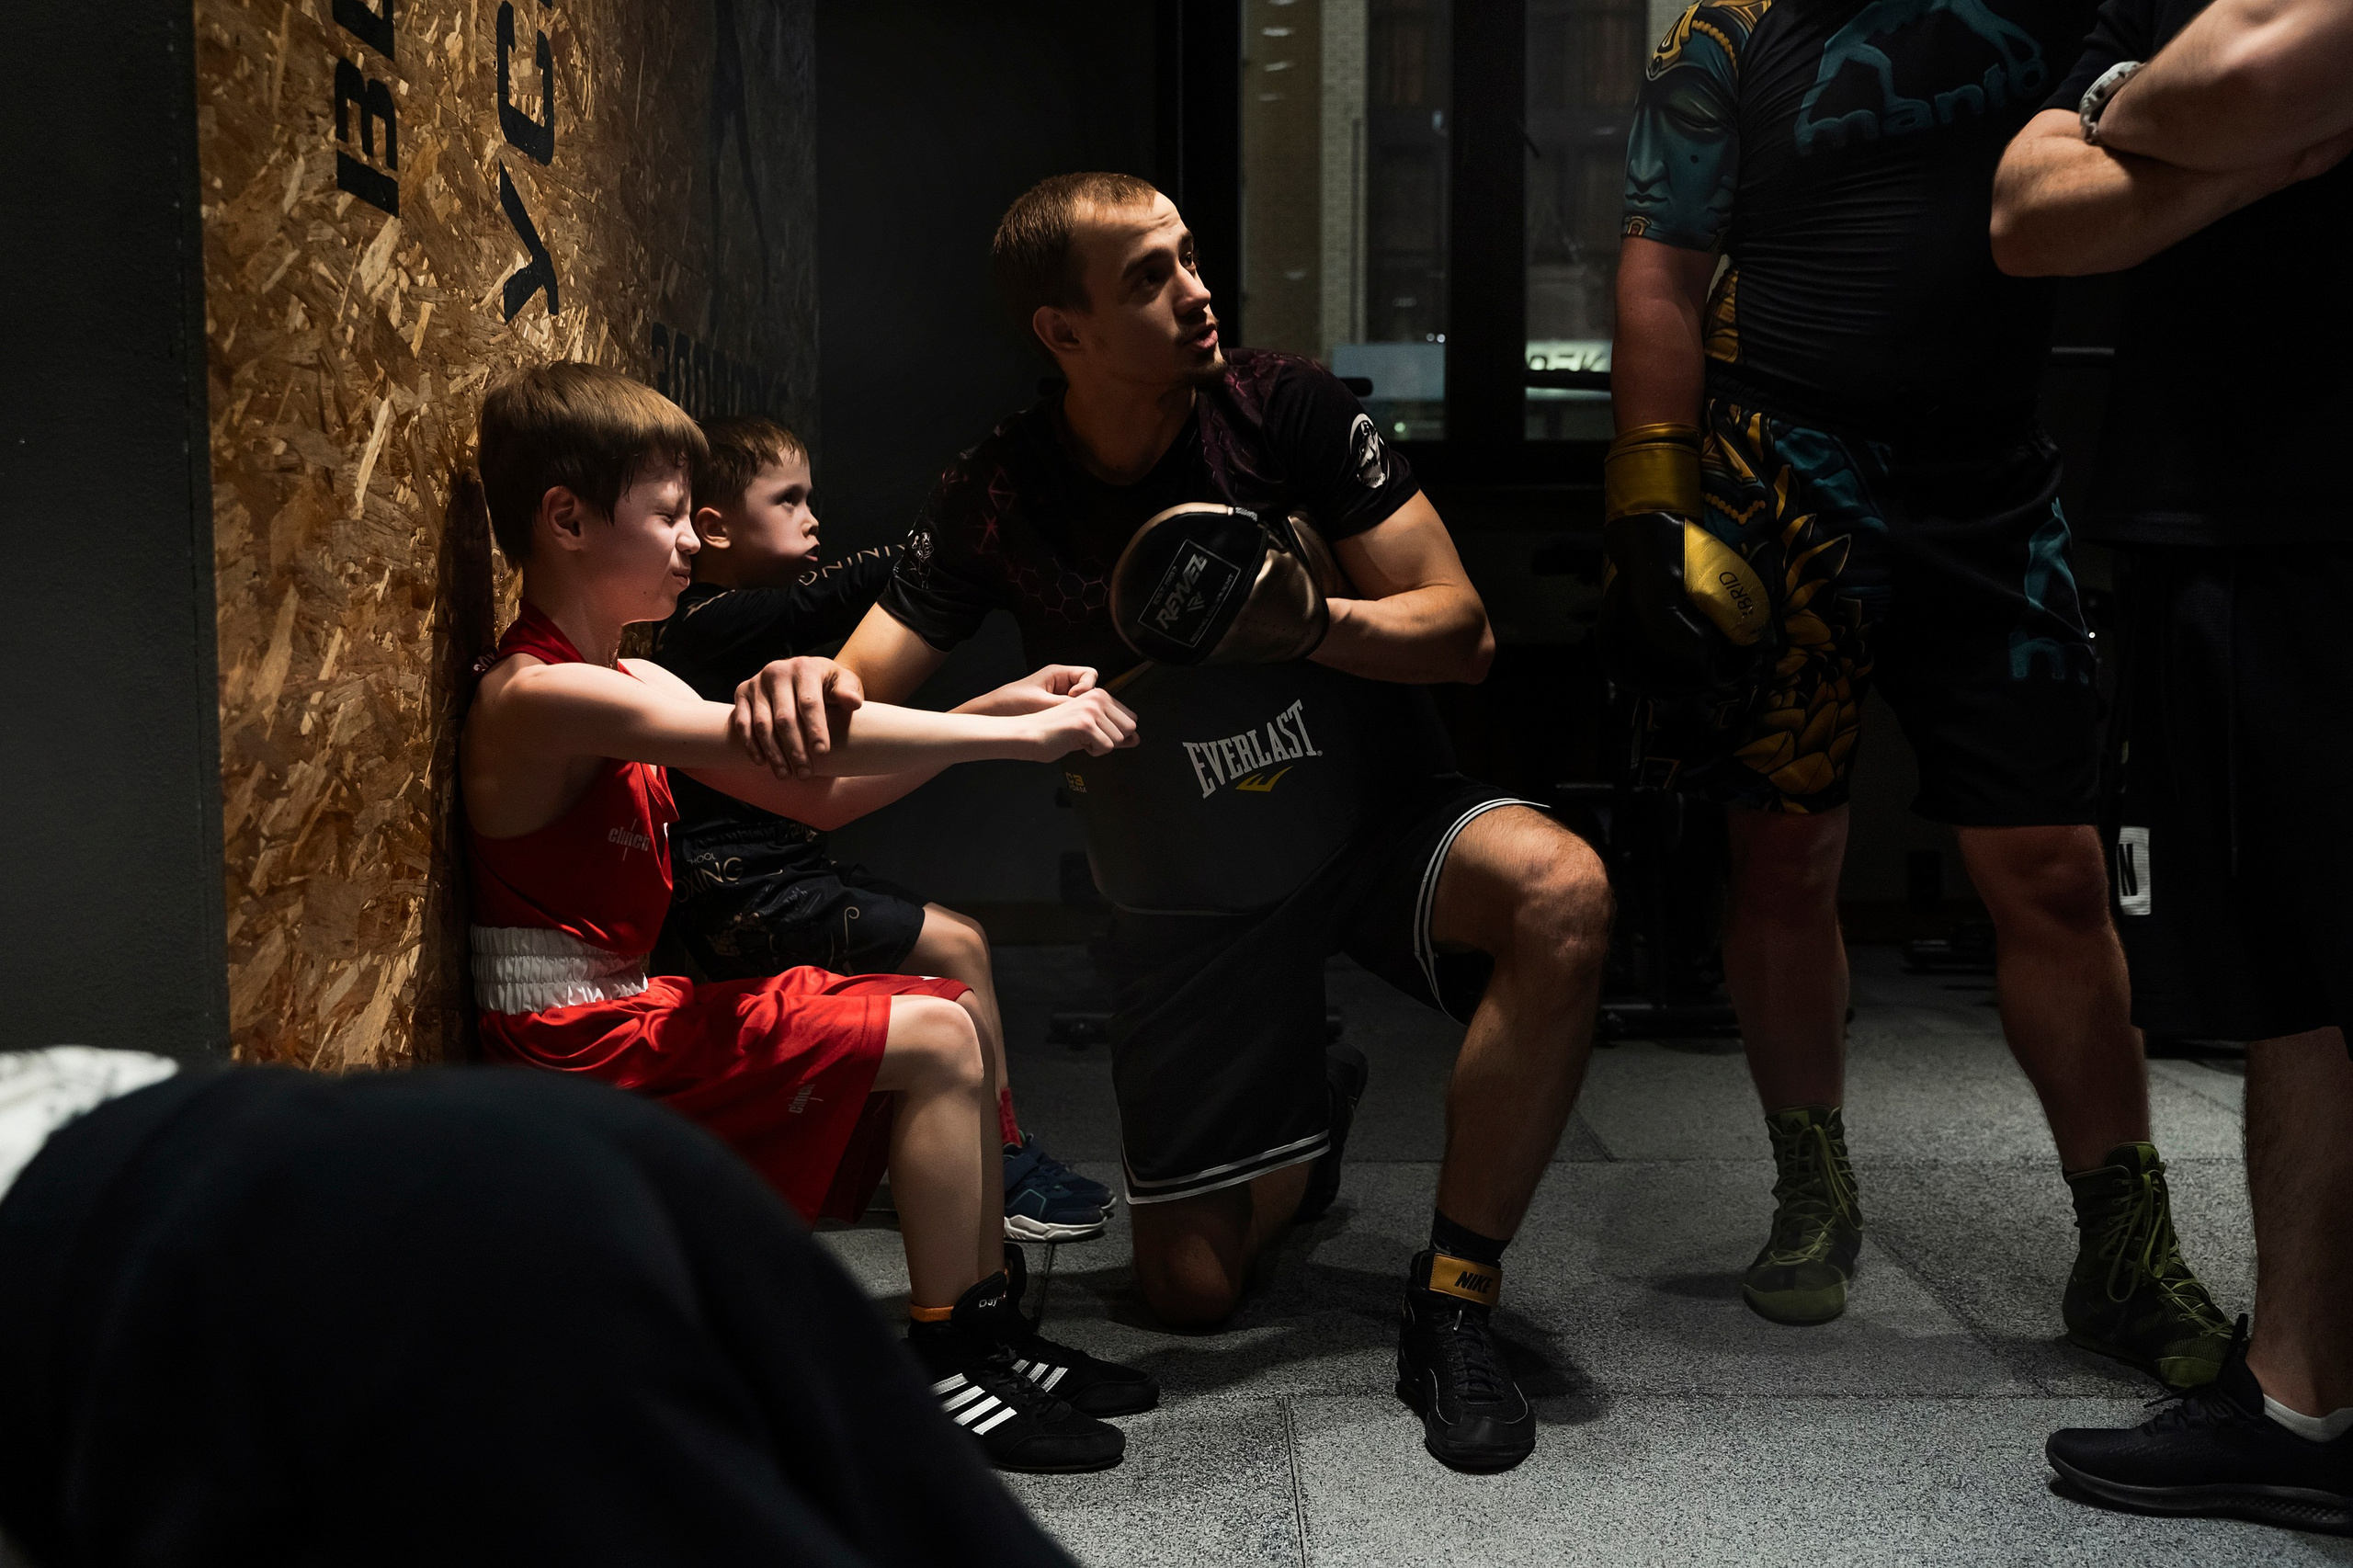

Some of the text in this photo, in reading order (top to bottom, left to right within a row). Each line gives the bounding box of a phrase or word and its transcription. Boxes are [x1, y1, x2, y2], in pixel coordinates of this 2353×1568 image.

[496, 0, 559, 324] УС
[1155, 553, 1209, 630] REYVEL
[1719, 572, 1753, 615] BRID
[1182, 699, 1318, 799] EVERLAST
[674, 856, 744, 903] OXING
[687, 852, 716, 865] HOOL
[1454, 1270, 1493, 1294] NIKE
